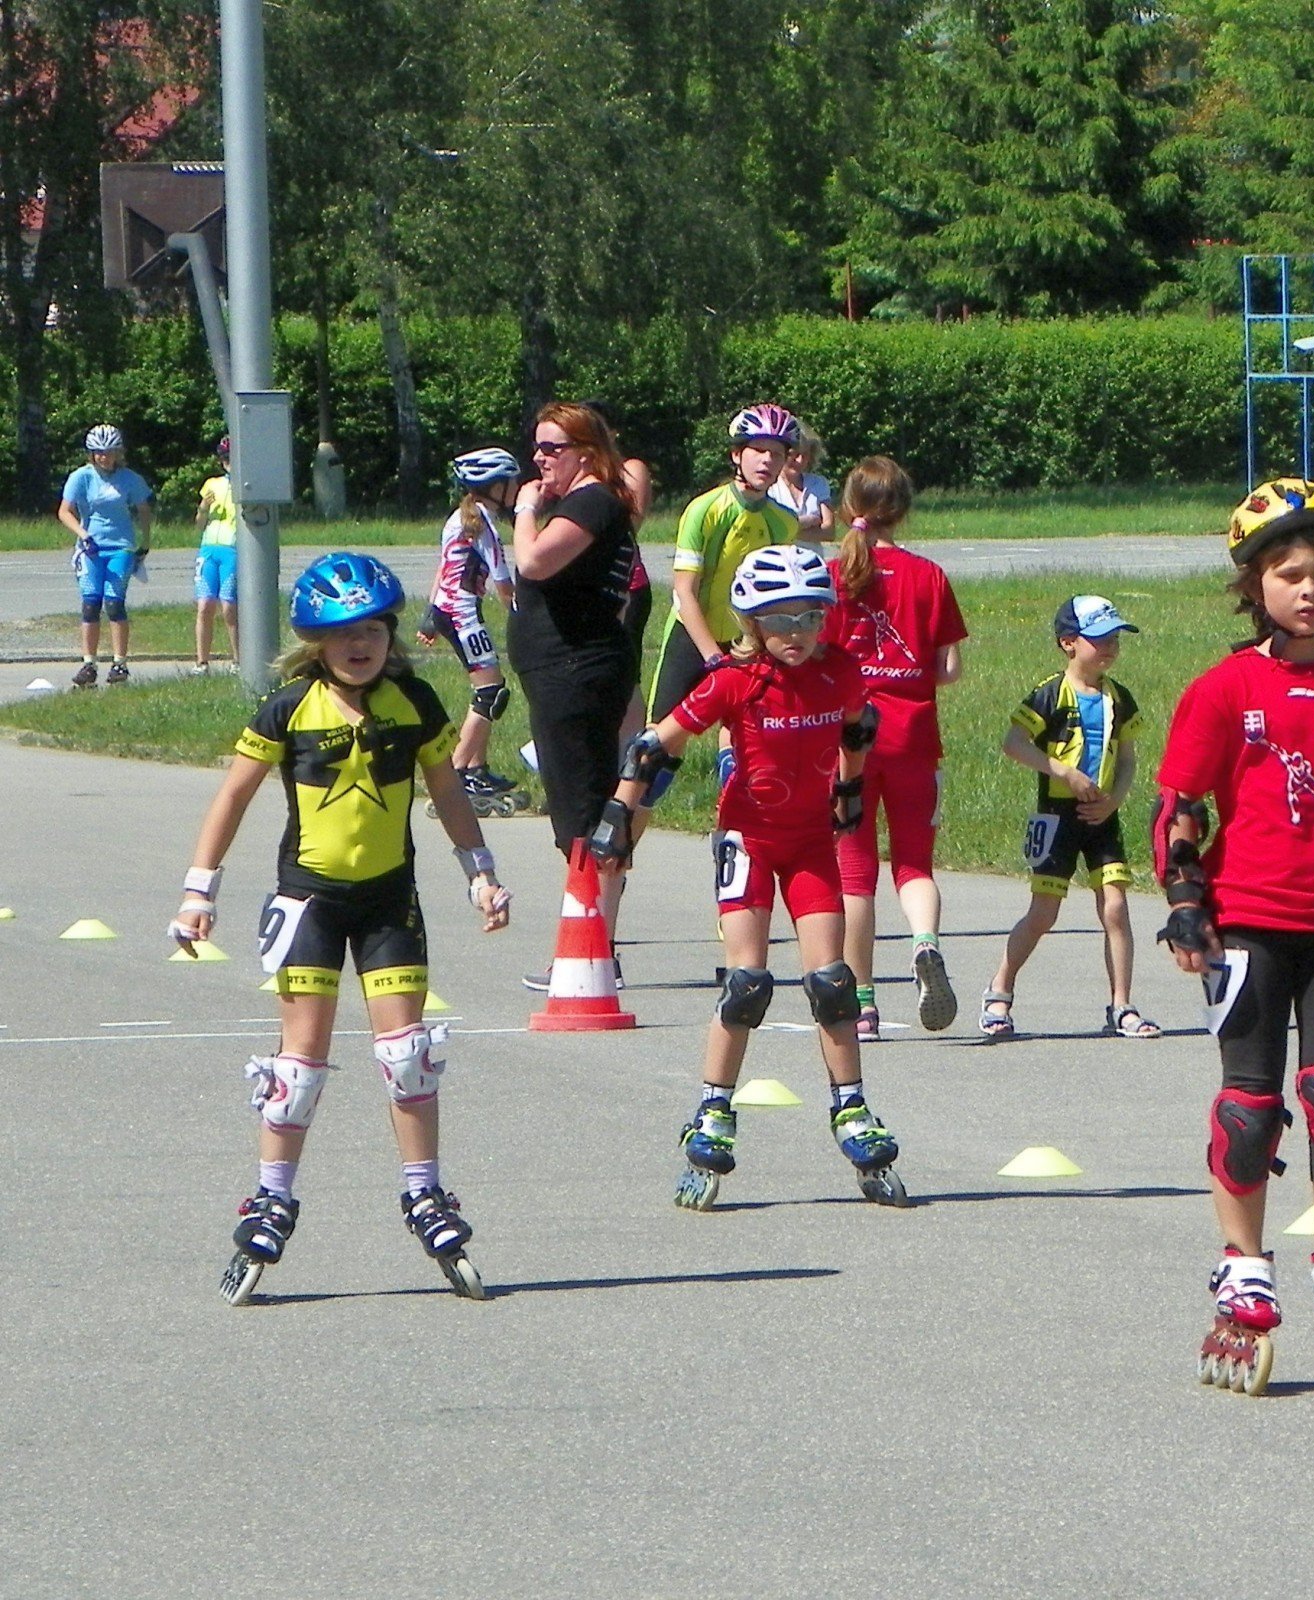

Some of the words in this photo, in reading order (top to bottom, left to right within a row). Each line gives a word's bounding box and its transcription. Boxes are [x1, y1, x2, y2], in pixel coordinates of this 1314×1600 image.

[467, 629, 493, 657] 86
[763, 717, 785, 729] RK
[1025, 820, 1047, 859] 59
[713, 840, 737, 888] 8
[288, 975, 307, 985] RTS
[374, 976, 393, 988] RTS
